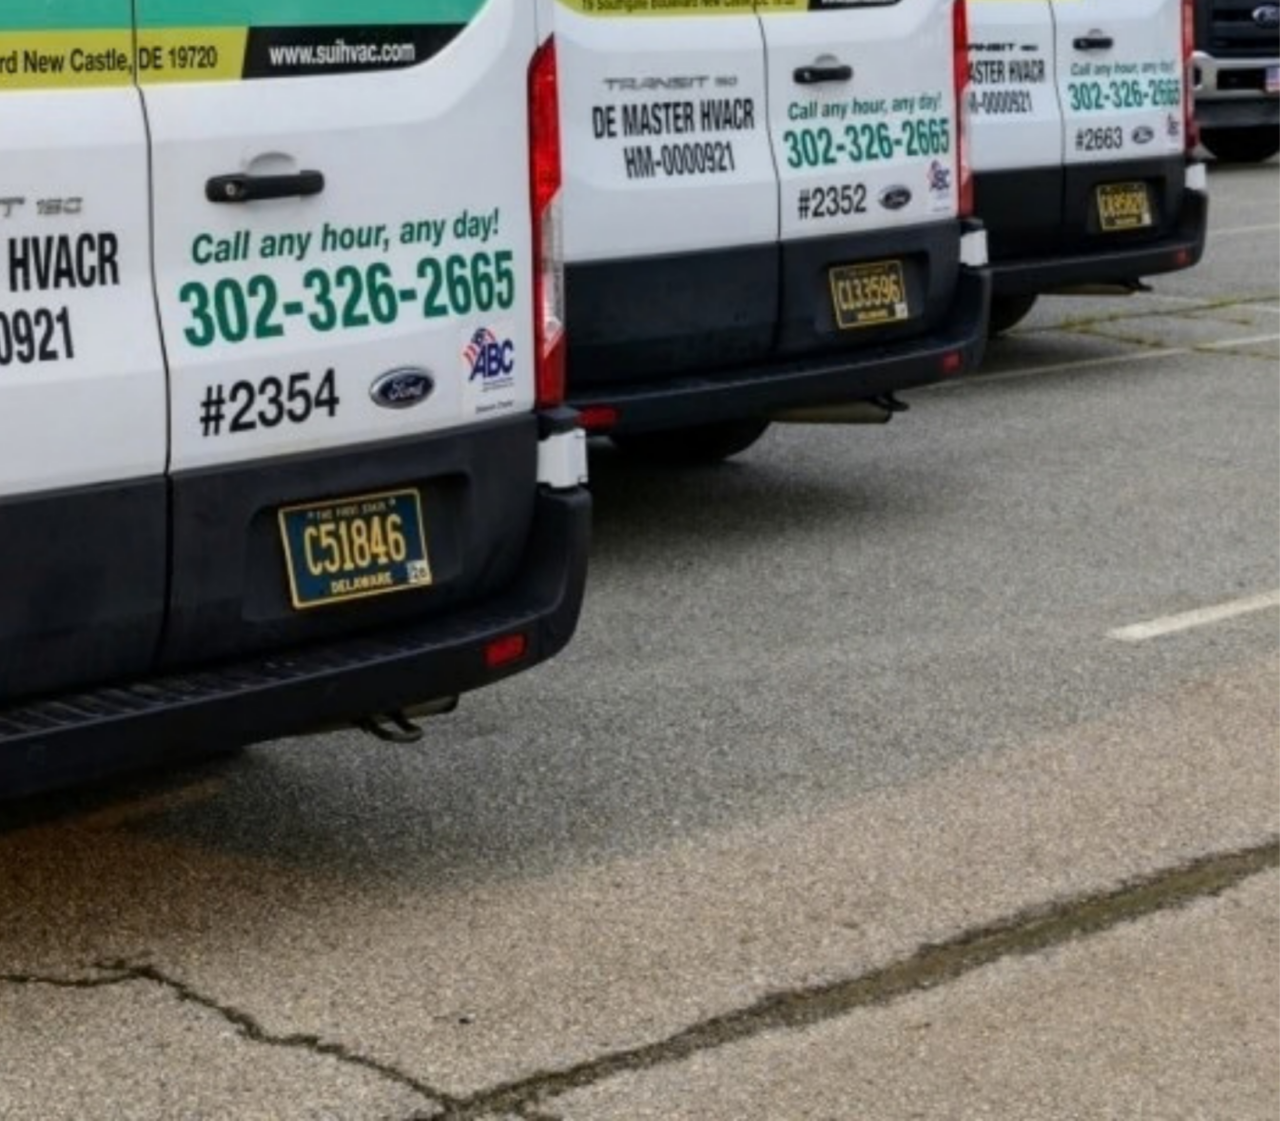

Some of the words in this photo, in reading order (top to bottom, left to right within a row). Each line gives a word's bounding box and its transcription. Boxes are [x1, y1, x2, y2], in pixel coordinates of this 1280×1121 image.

[23, 49, 64, 74] New
[69, 48, 134, 77] Castle,
[139, 46, 163, 70] DE
[169, 45, 218, 68] 19720
[269, 38, 416, 67] www.suihvac.com
[968, 59, 1006, 85] ASTER
[592, 105, 618, 140] DE
[623, 101, 696, 138] MASTER
[700, 98, 755, 132] HVACR
[788, 101, 819, 122] Call
[821, 101, 848, 121] any
[852, 97, 889, 116] hour,
[892, 96, 915, 115] any
[783, 117, 951, 169] 302-326-2665
[1075, 126, 1124, 152] #2663
[624, 140, 736, 179] HM-0000921
[798, 183, 868, 221] #2352
[191, 231, 251, 265] Call
[260, 231, 311, 261] any
[321, 223, 390, 253] hour,
[399, 217, 446, 248] any
[453, 207, 500, 242] day!
[8, 231, 120, 293] HVACR
[179, 250, 515, 348] 302-326-2665
[469, 338, 515, 383] ABC
[200, 367, 340, 437] #2354
[303, 513, 407, 576] C51846
[330, 571, 394, 595] DELAWARE
